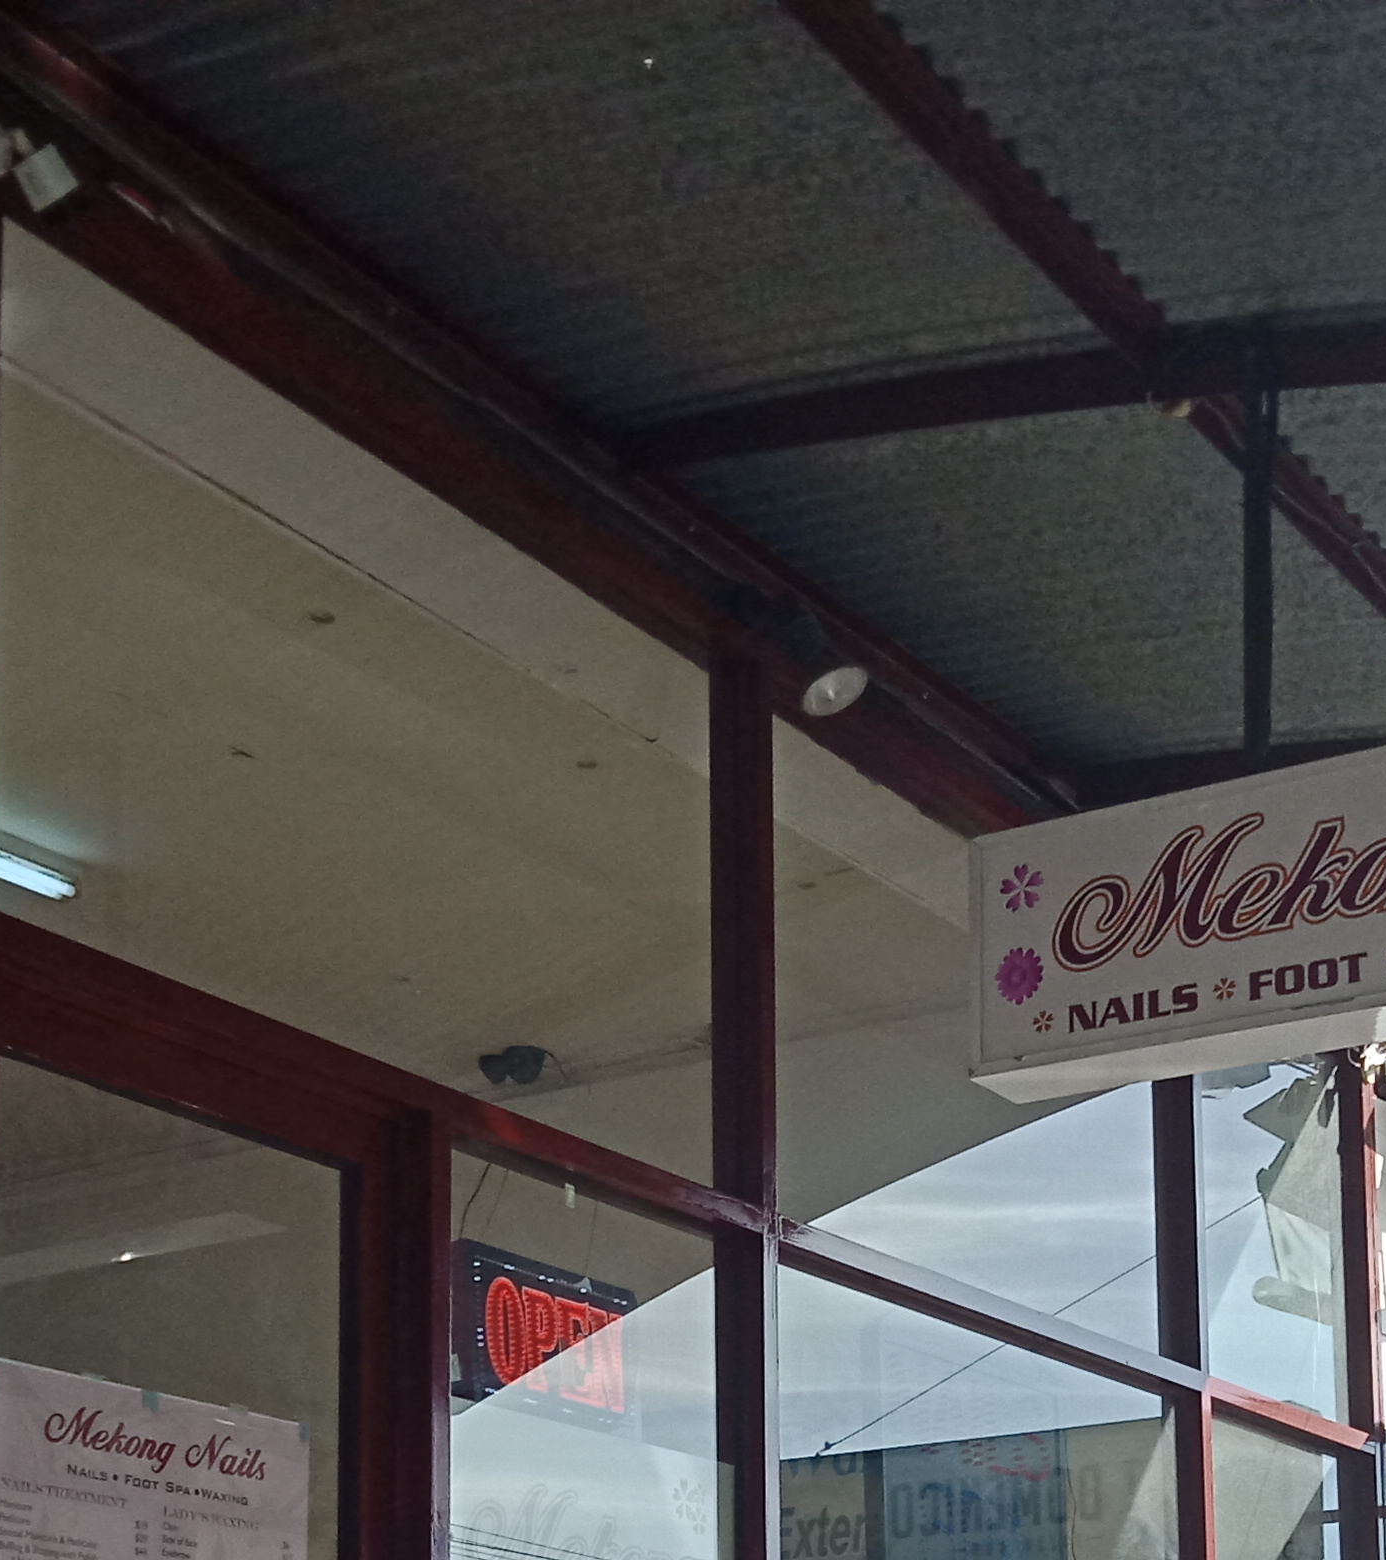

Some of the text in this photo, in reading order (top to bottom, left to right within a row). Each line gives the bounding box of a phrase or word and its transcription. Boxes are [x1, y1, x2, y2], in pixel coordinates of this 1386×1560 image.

[1068, 983, 1199, 1034] NAILS
[1247, 949, 1365, 1001] FOOT
[485, 1277, 625, 1413] OPEN
[44, 1407, 266, 1481] Mekong Nails
[125, 1474, 159, 1490] FOOT
[166, 1481, 190, 1495] SPA
